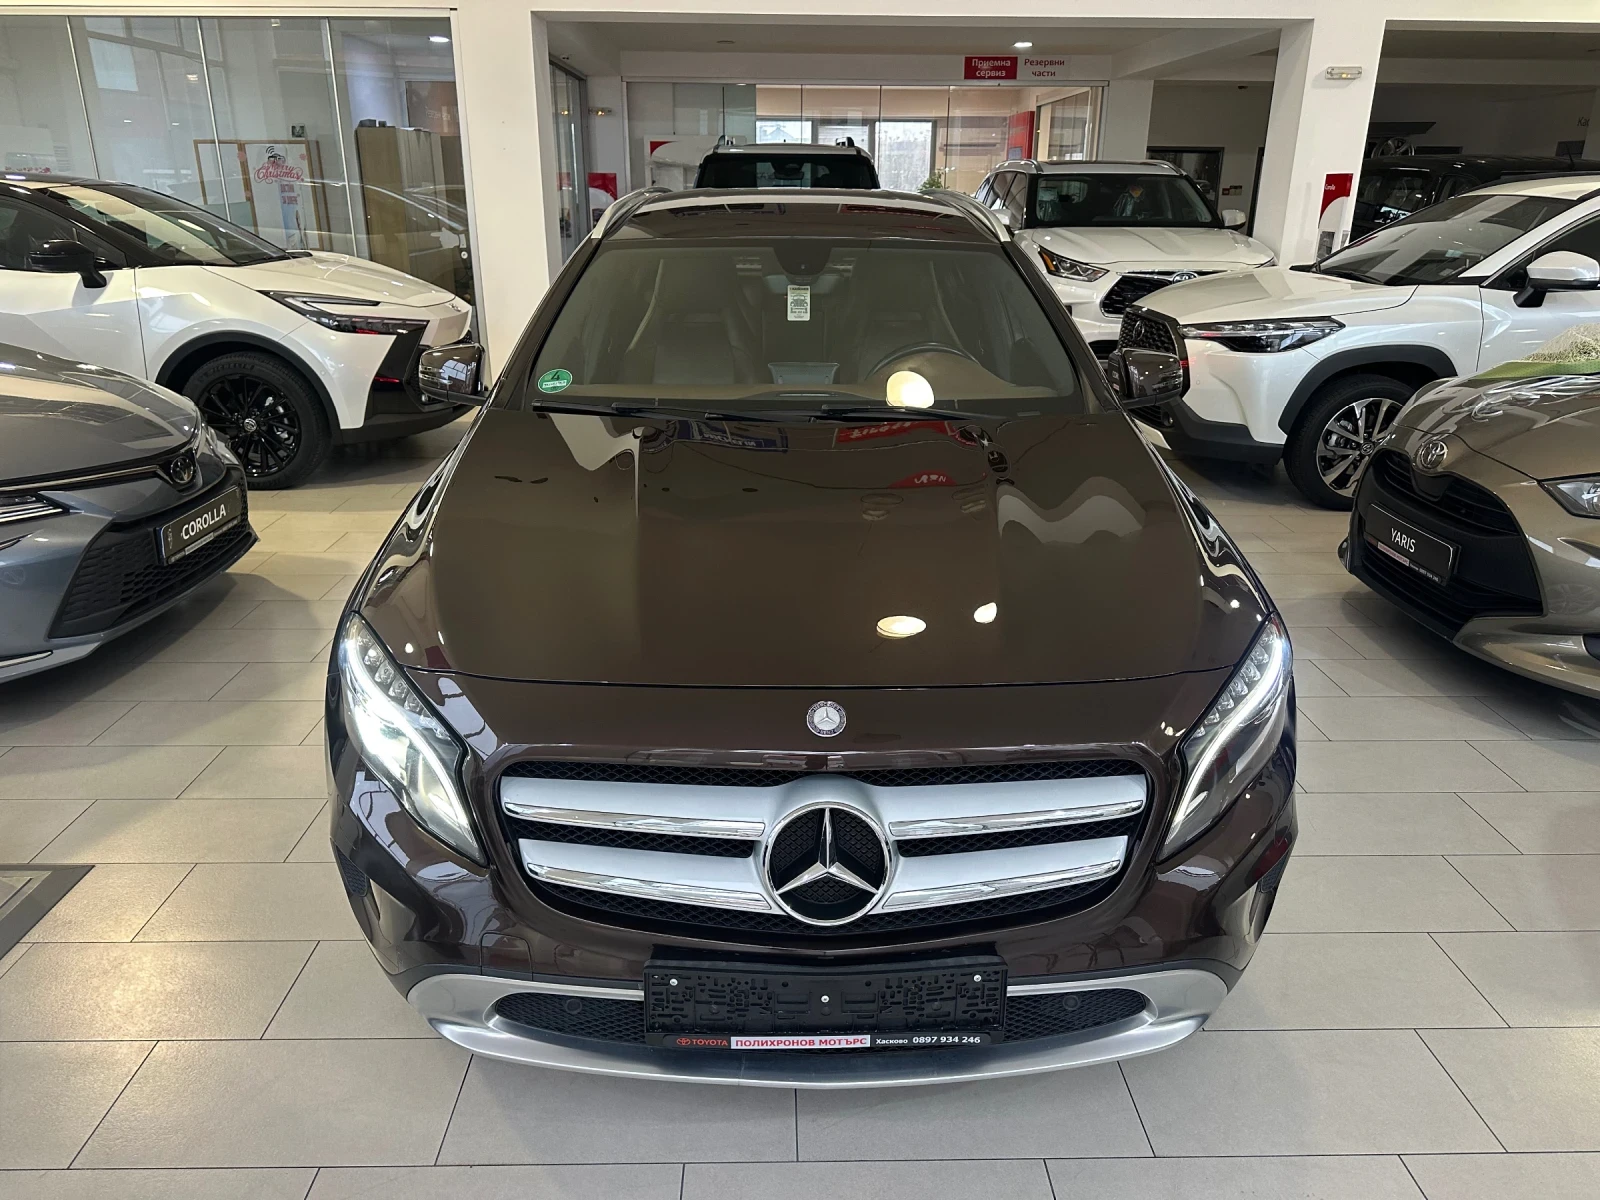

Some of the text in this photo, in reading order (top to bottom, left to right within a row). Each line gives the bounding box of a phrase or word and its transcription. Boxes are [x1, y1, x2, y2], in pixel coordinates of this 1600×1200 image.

[972, 58, 1011, 68] Приемна
[1024, 58, 1065, 68] Резервни
[976, 70, 1006, 78] сервиз
[254, 166, 304, 184] Christmas
[551, 370, 560, 380] 4
[181, 503, 227, 540] COROLLA
[1391, 527, 1416, 553] YARIS
[735, 1039, 816, 1047] ПОЛИХРОНОВ
[819, 1037, 867, 1046] МОТЪРС
[912, 1036, 938, 1044] 0897
[961, 1036, 981, 1044] 246
